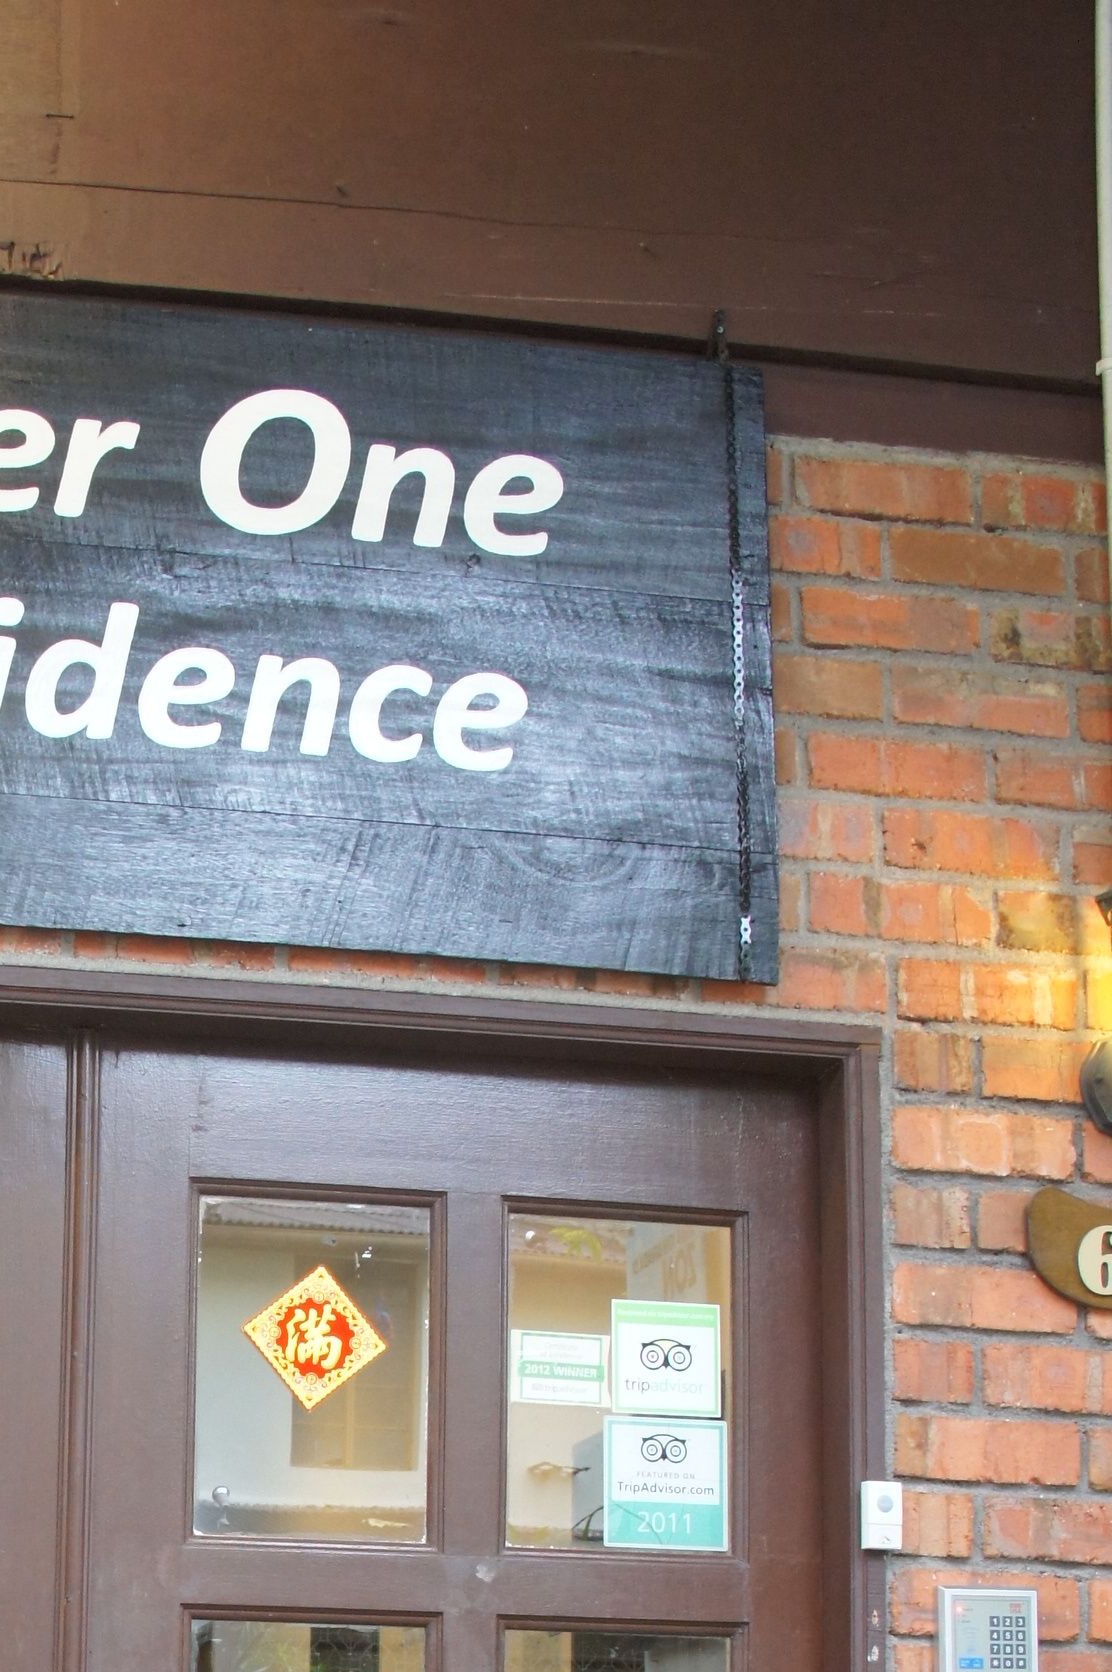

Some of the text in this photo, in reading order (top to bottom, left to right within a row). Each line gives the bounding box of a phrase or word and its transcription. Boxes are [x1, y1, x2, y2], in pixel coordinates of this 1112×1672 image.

[198, 389, 565, 557] One
[524, 1363, 597, 1379] 2012 WINNER
[624, 1377, 704, 1395] tripadvisor
[617, 1480, 715, 1496] TripAdvisor.com
[637, 1510, 693, 1534] 2011
